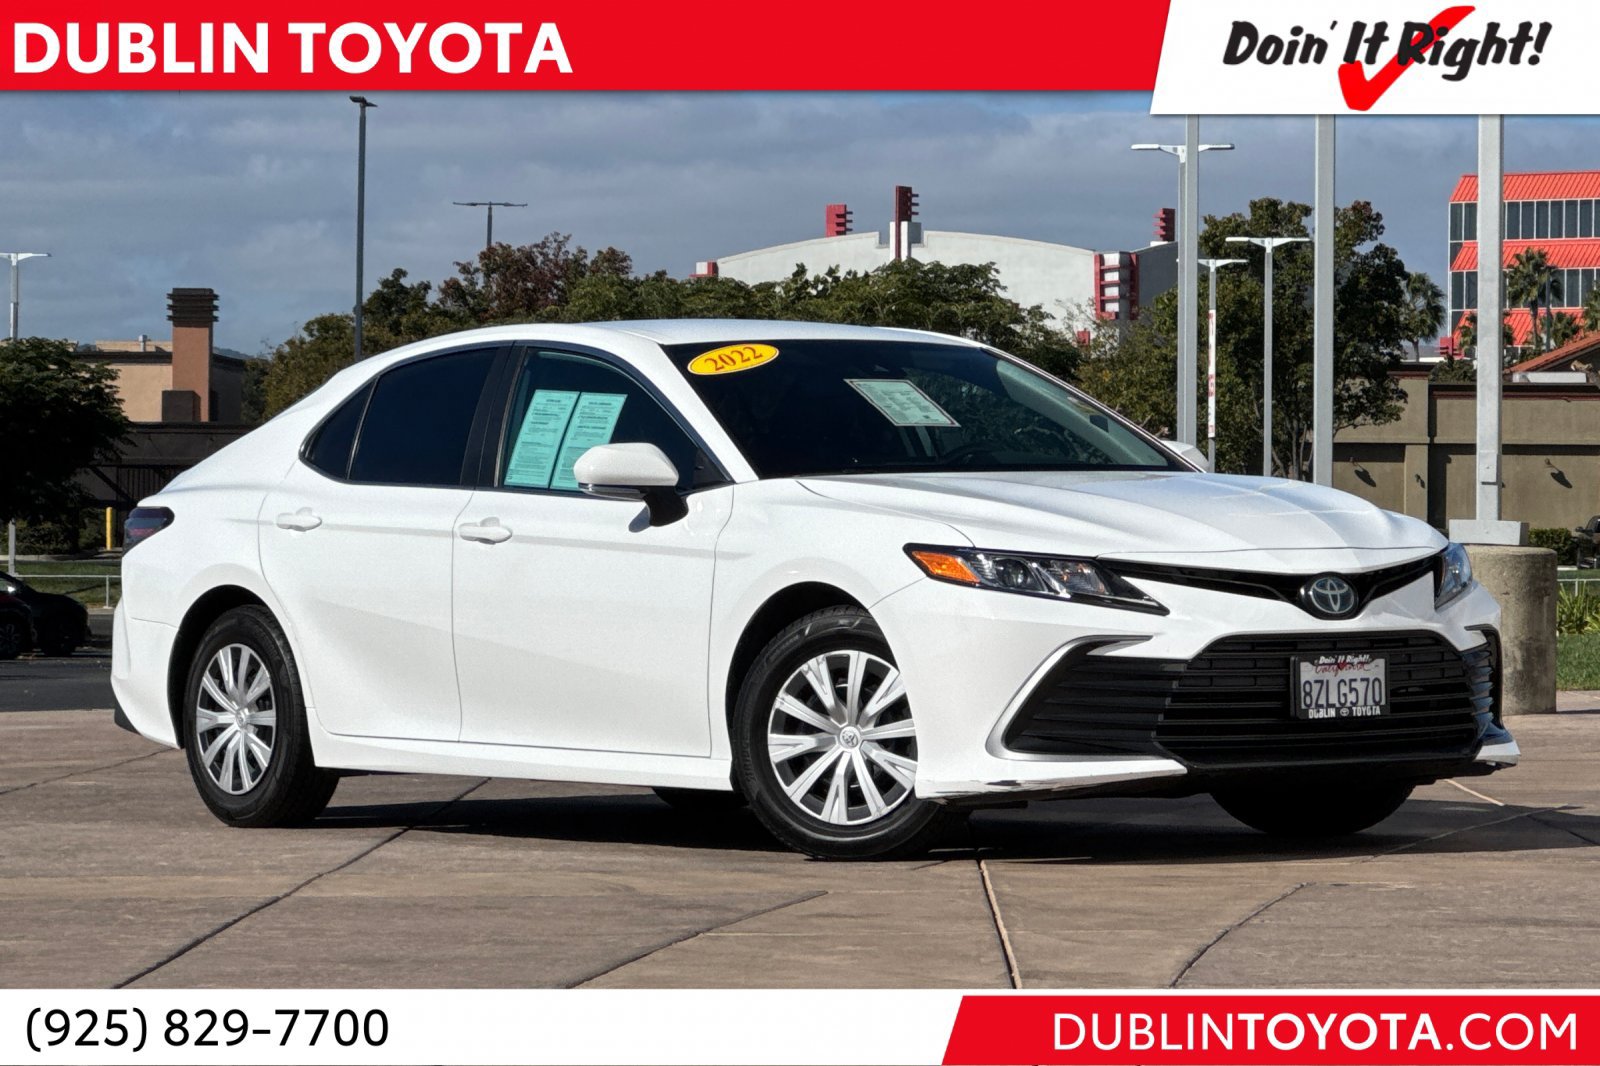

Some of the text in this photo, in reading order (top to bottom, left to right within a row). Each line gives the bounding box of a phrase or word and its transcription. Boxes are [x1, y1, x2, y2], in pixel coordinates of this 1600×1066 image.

[704, 346, 763, 371] 2022
[1302, 677, 1383, 709] 8ZLG570
[1308, 705, 1381, 719] DUBLIN TOYOTA
